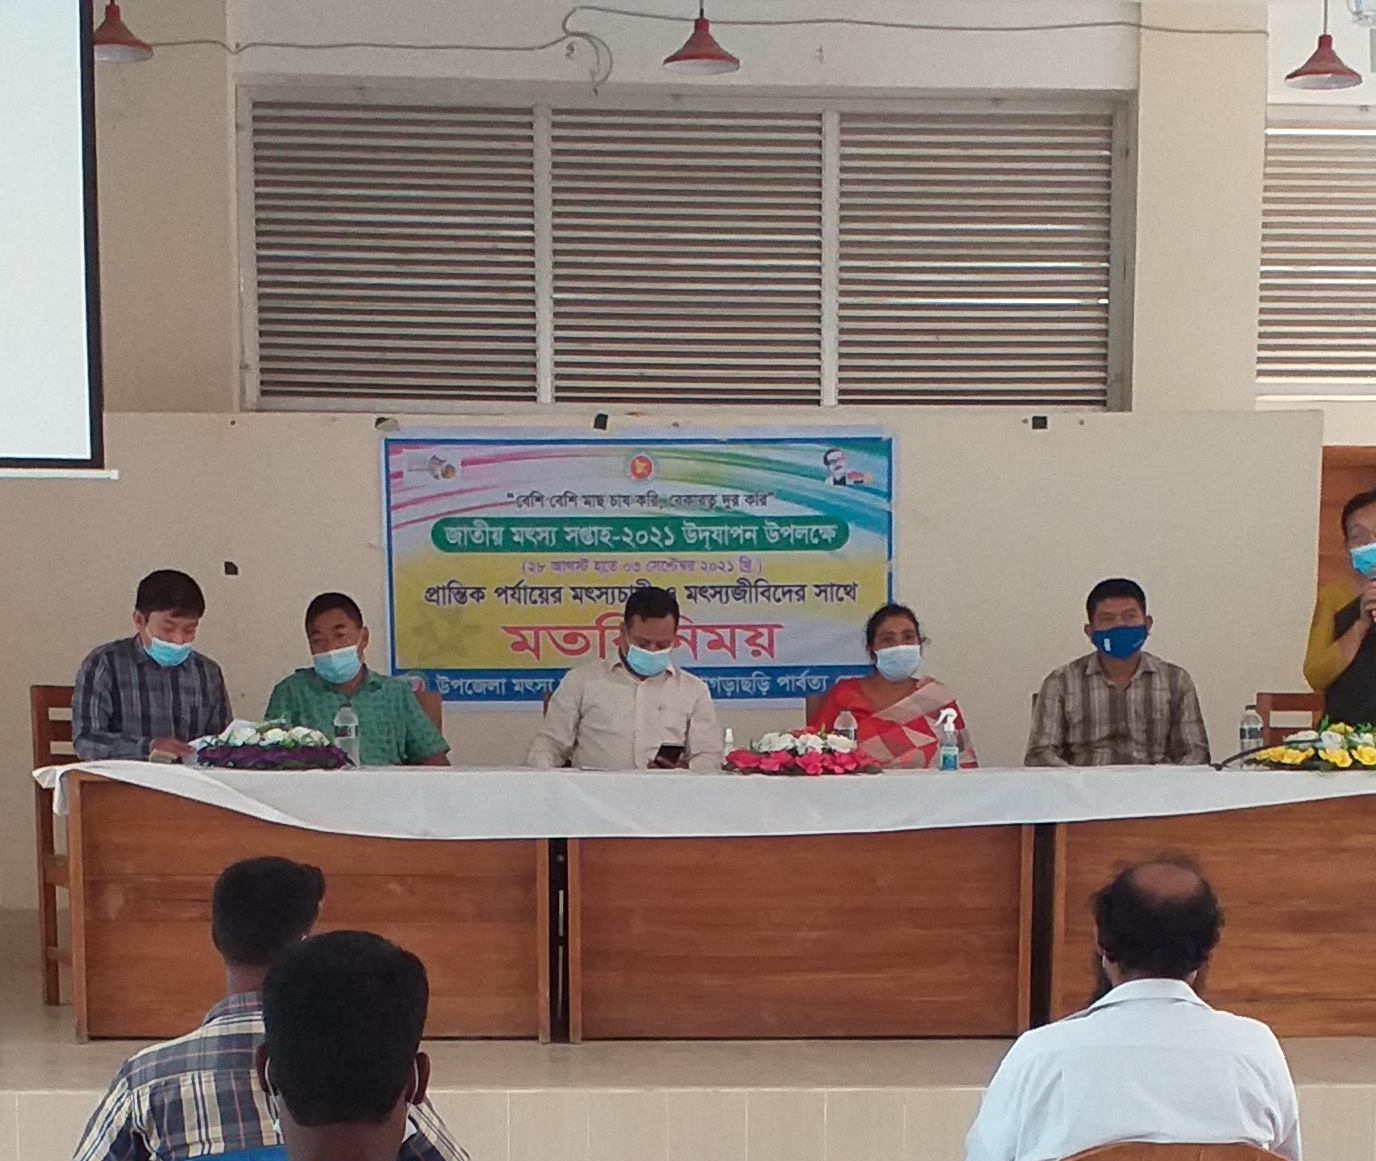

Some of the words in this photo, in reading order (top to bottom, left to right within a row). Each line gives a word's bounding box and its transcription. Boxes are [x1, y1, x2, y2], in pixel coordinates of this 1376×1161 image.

[549, 490, 578, 508] বেশি
[581, 494, 606, 509] মাছ
[609, 494, 631, 508] চাষ
[443, 519, 505, 547] জাতীয়
[509, 526, 558, 547] মৎস্য
[563, 525, 674, 548] সপ্তাহ-২০২১
[762, 519, 838, 546] উপলক্ষে
[593, 560, 618, 574] হতে
[623, 562, 642, 573] ০৩
[700, 560, 734, 573] ২০২১
[424, 579, 487, 606] প্রান্তিক
[494, 578, 564, 606] পর্যায়ের
[569, 579, 652, 606] মৎস্যচা
[684, 577, 808, 605] মৎস্যজীবিদের
[812, 581, 859, 604] সাথে
[435, 673, 508, 696] উপজেলা
[699, 670, 772, 697] গড়াছড়ি
[776, 669, 830, 693] পার্বত্য
